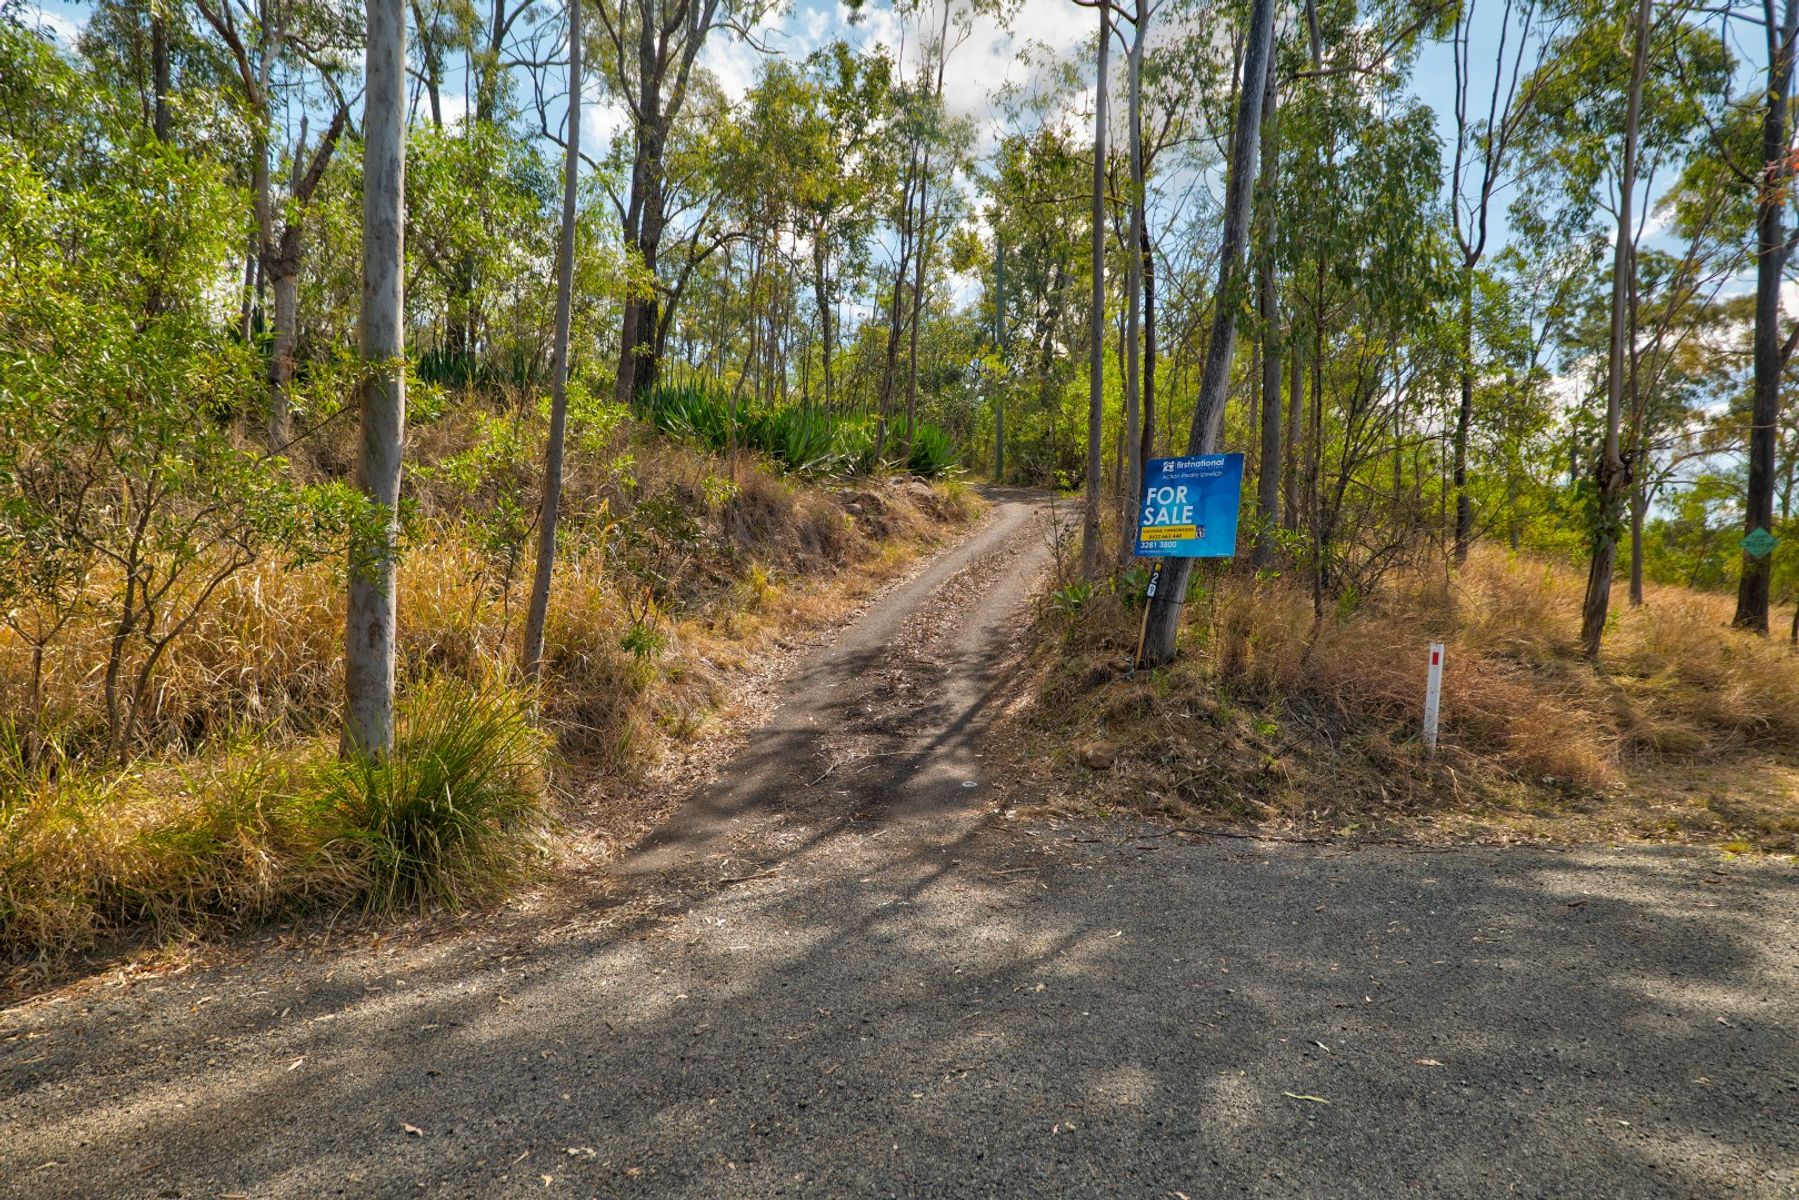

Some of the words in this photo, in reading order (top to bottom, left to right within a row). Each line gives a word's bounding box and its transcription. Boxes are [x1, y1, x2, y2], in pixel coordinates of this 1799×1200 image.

[1176, 458, 1224, 468] firstnational
[1146, 486, 1187, 505] FOR
[1143, 506, 1193, 525] SALE
